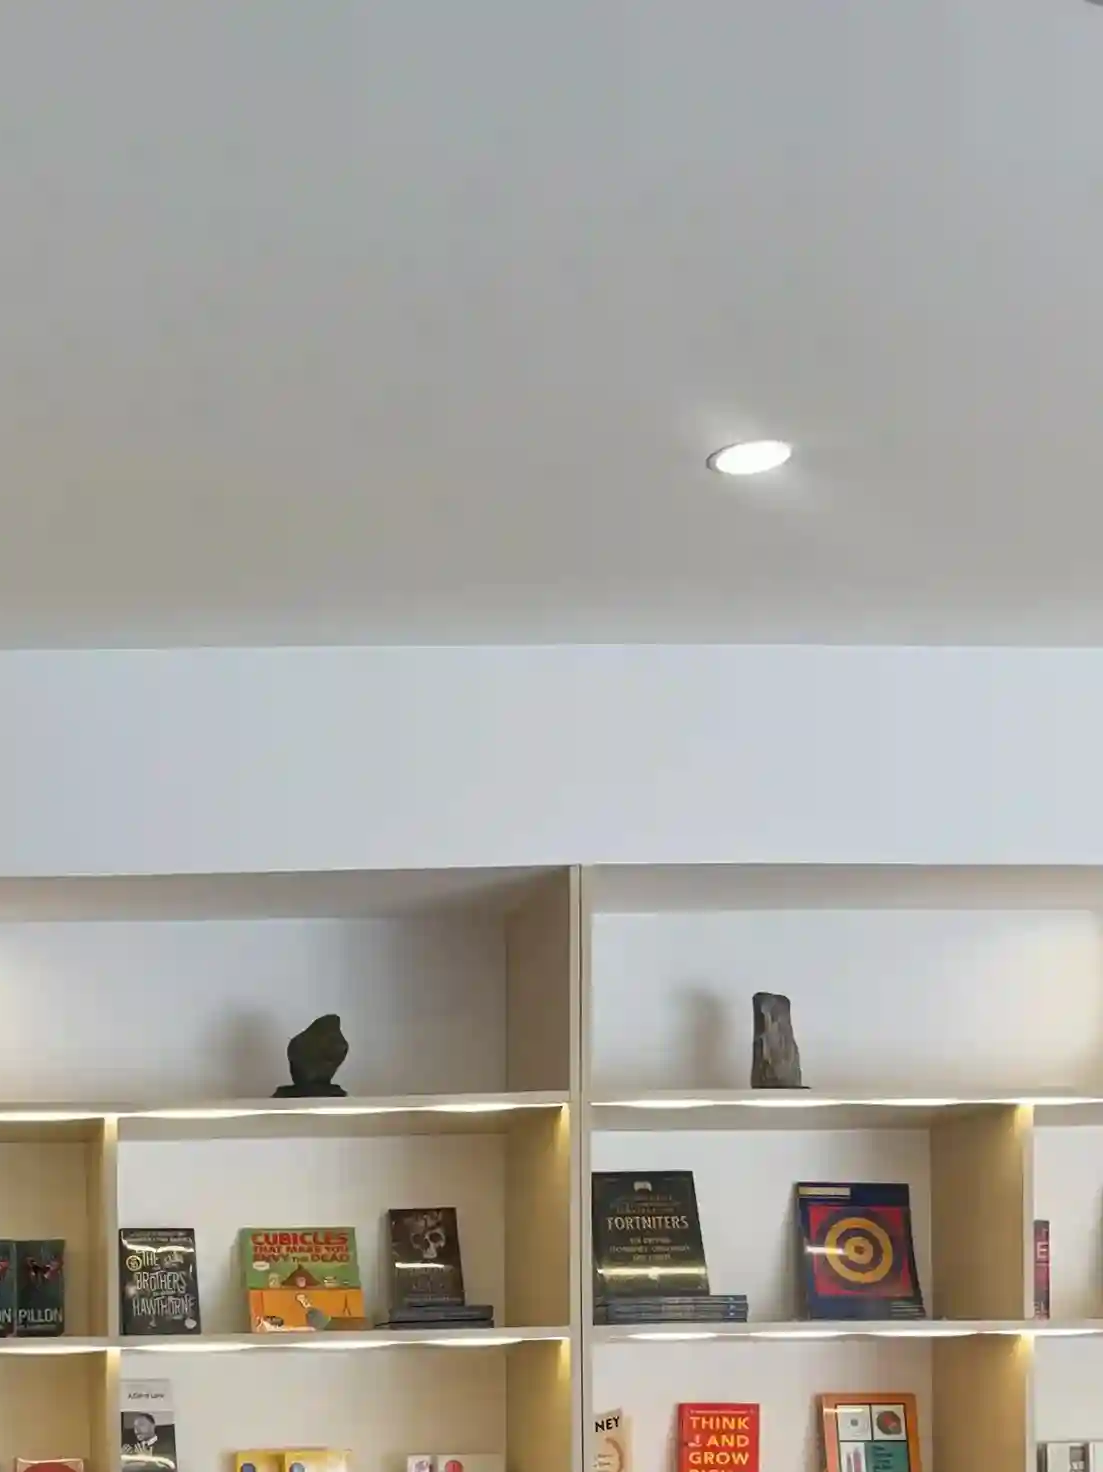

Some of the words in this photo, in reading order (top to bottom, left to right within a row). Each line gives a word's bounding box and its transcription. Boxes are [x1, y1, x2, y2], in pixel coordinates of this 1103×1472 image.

[606, 1216, 689, 1230] FORTNITERS
[251, 1232, 349, 1245] CUBICLES
[310, 1254, 349, 1262] DEAD
[135, 1270, 187, 1292] BROTHERS
[132, 1295, 196, 1319] HAWTHORNE
[18, 1307, 62, 1323] PILLON
[595, 1416, 620, 1433] NEY
[690, 1416, 750, 1430] THINK
[706, 1435, 750, 1448] AND
[689, 1452, 750, 1465] GROW
